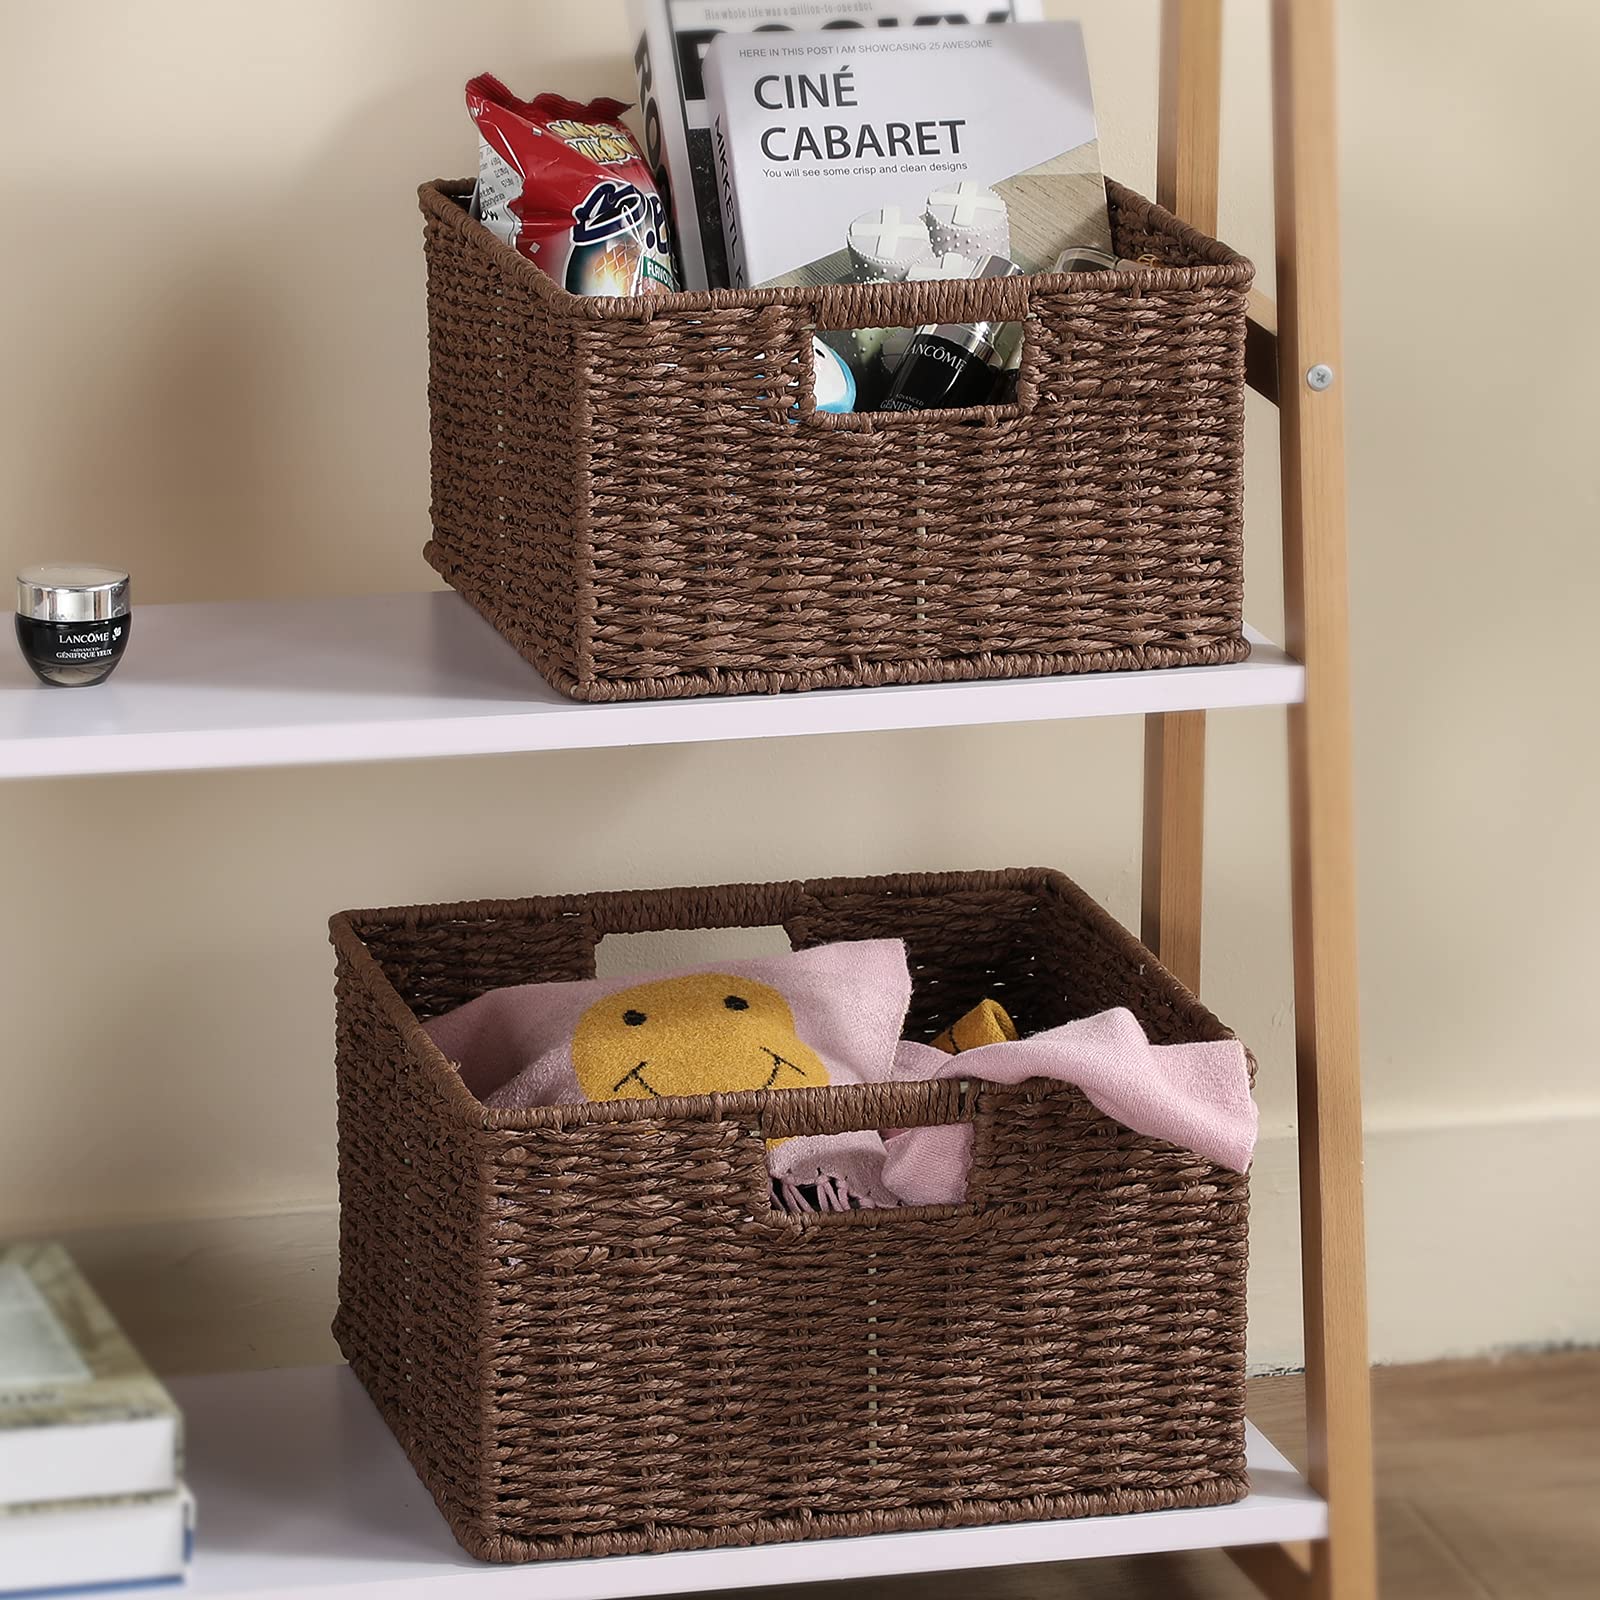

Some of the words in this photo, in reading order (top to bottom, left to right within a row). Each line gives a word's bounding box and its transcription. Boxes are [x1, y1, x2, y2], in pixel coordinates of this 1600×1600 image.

[739, 48, 767, 58] HERE
[769, 49, 780, 57] IN
[782, 47, 804, 57] THIS
[806, 47, 833, 56] POST
[840, 45, 857, 54] AM
[858, 43, 927, 54] SHOWCASING
[929, 41, 941, 50] 25
[942, 39, 993, 50] AWESOME
[754, 65, 858, 110] CINÉ
[760, 120, 966, 161] CABARET
[763, 168, 782, 178] You
[784, 167, 800, 178] will
[802, 169, 821, 177] see
[823, 168, 850, 177] some
[853, 166, 877, 178] crisp
[879, 164, 898, 174] and
[900, 163, 927, 173] clean
[929, 161, 968, 174] designs
